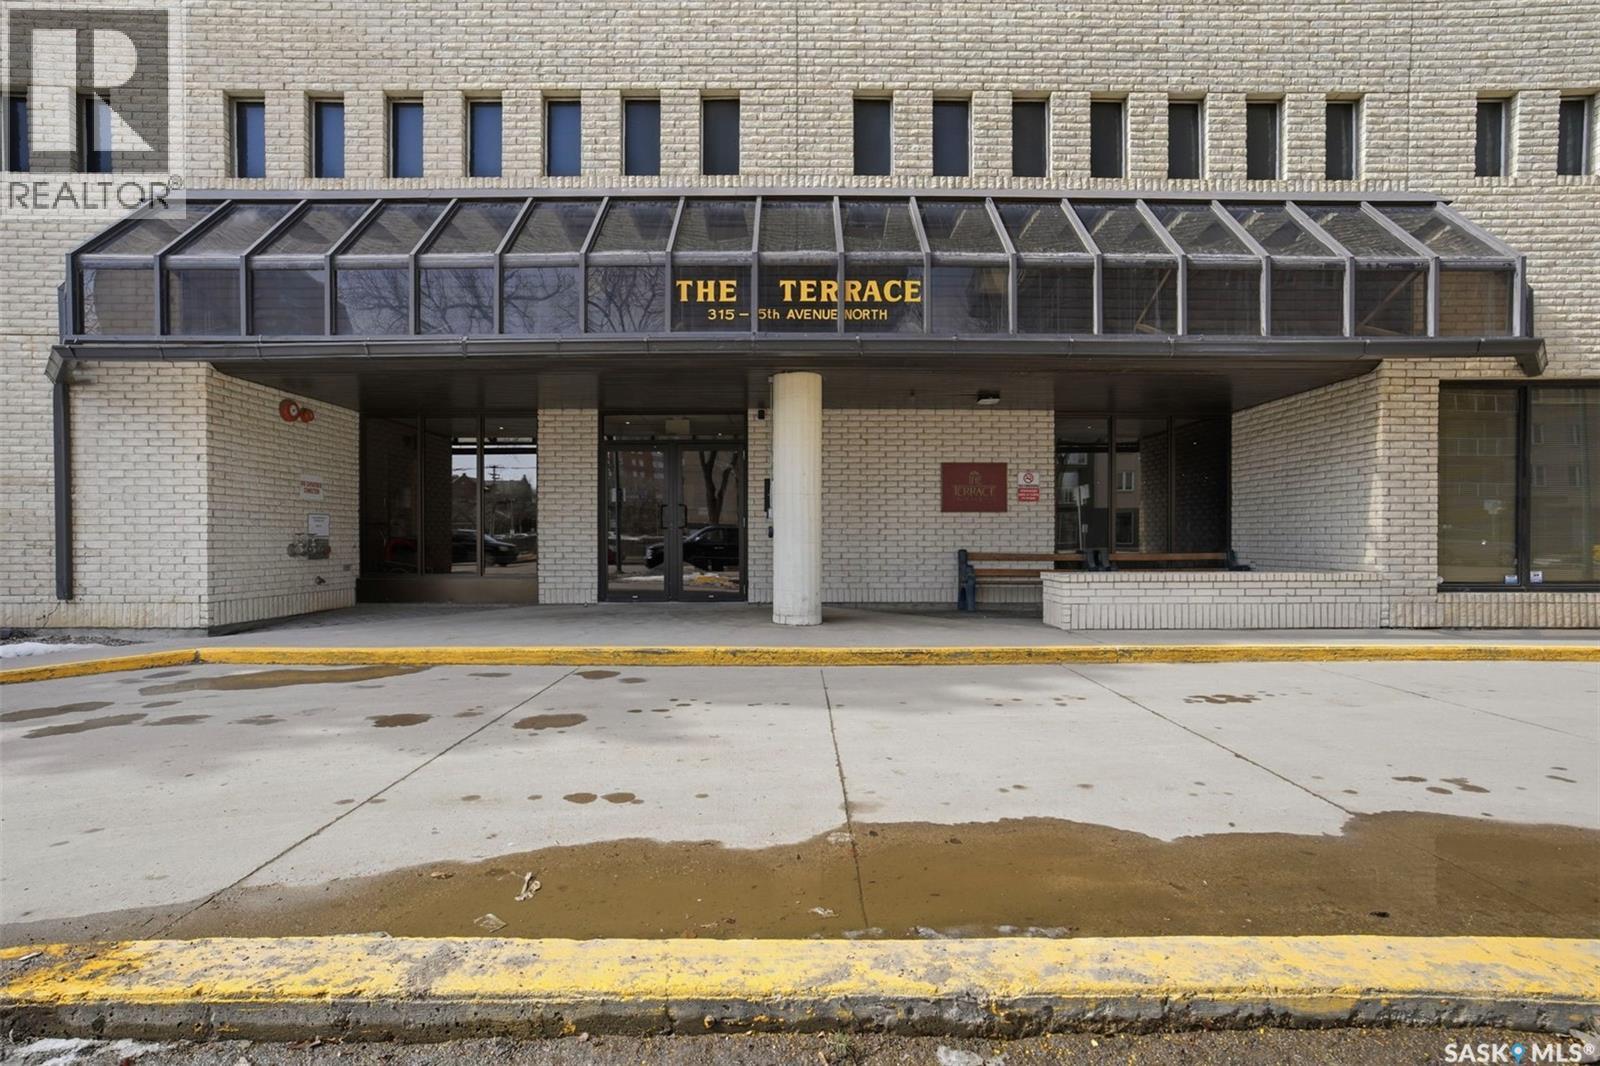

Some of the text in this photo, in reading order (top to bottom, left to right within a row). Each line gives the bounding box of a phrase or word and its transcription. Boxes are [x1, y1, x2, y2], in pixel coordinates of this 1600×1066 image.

[676, 280, 921, 302] THE TERRACE
[708, 309, 735, 320] 315
[758, 309, 780, 320] 5th
[786, 309, 838, 320] AVENUE
[844, 309, 888, 320] NORTH
